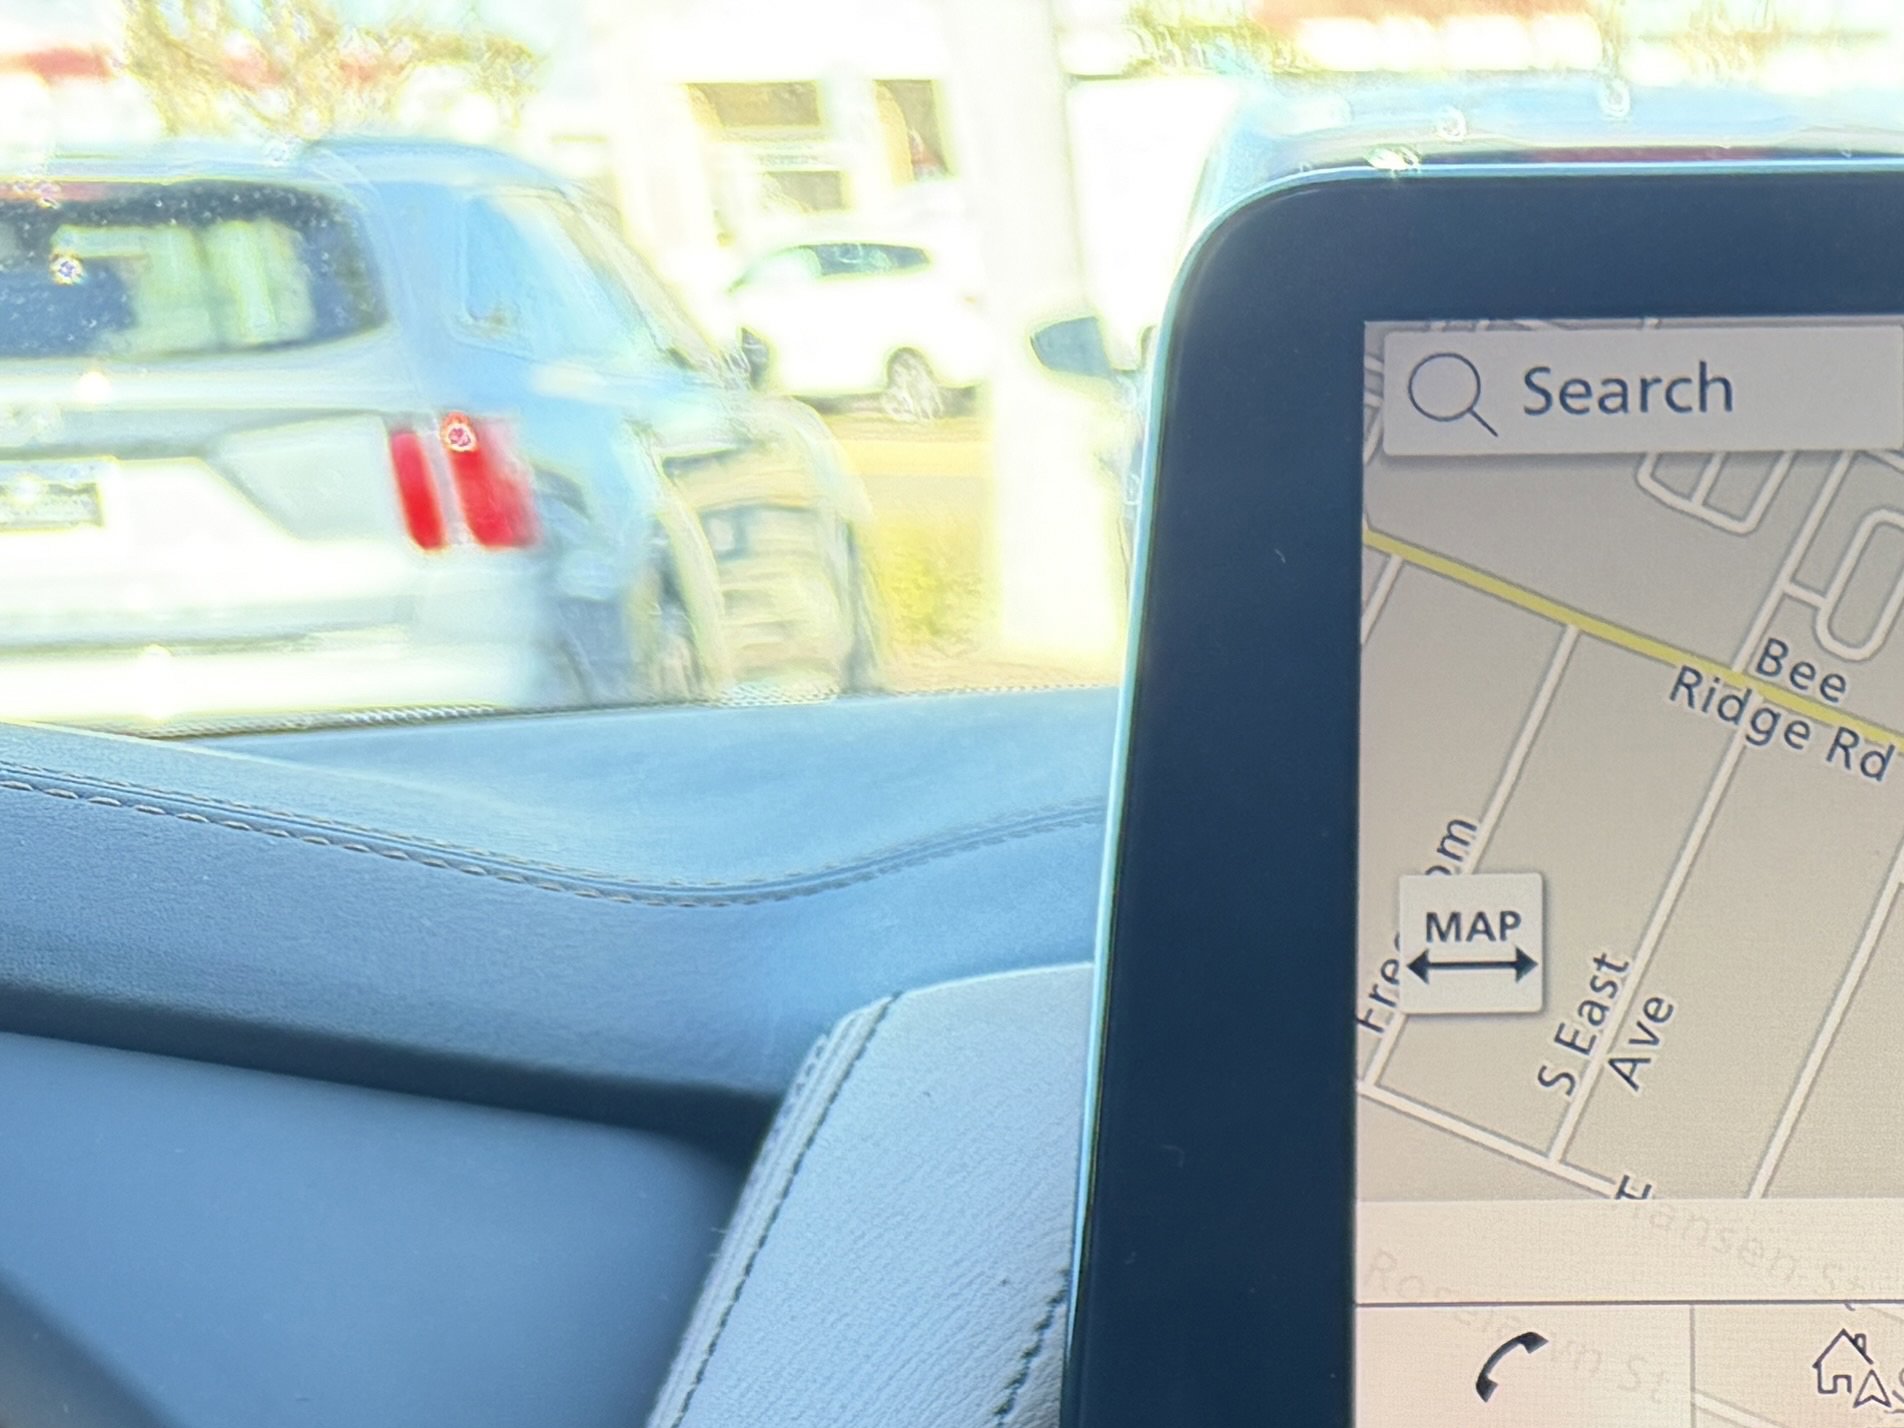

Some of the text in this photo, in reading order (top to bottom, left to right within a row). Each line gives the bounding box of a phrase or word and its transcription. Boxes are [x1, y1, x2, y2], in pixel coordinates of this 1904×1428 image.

[1521, 359, 1735, 417] Search
[1754, 636, 1848, 704] Bee
[1667, 664, 1896, 784] Ridge Rd
[1425, 911, 1523, 943] MAP
[1537, 952, 1631, 1096] S East
[1607, 994, 1676, 1091] Ave
